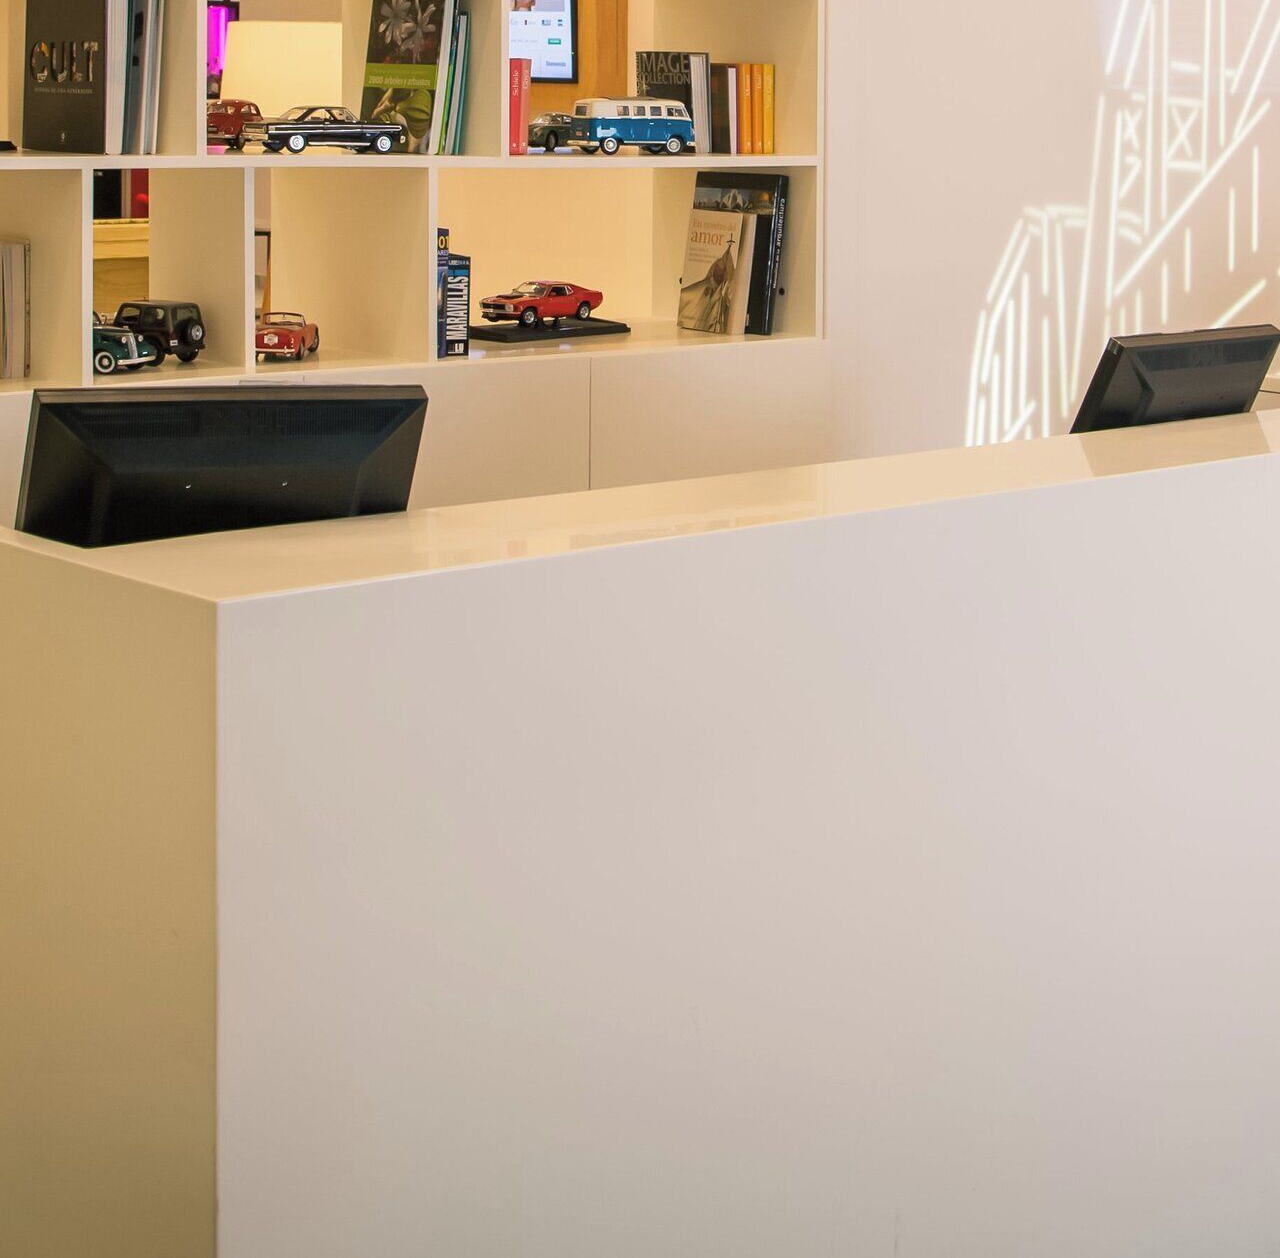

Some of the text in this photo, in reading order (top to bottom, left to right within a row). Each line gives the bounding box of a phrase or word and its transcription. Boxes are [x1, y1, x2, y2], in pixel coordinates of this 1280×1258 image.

[31, 41, 99, 83] CULT
[639, 52, 690, 73] IMAGE
[639, 72, 691, 85] COLLECTION
[776, 198, 786, 247] arquitectura
[690, 231, 725, 246] amor
[446, 276, 469, 340] MARAVILLAS
